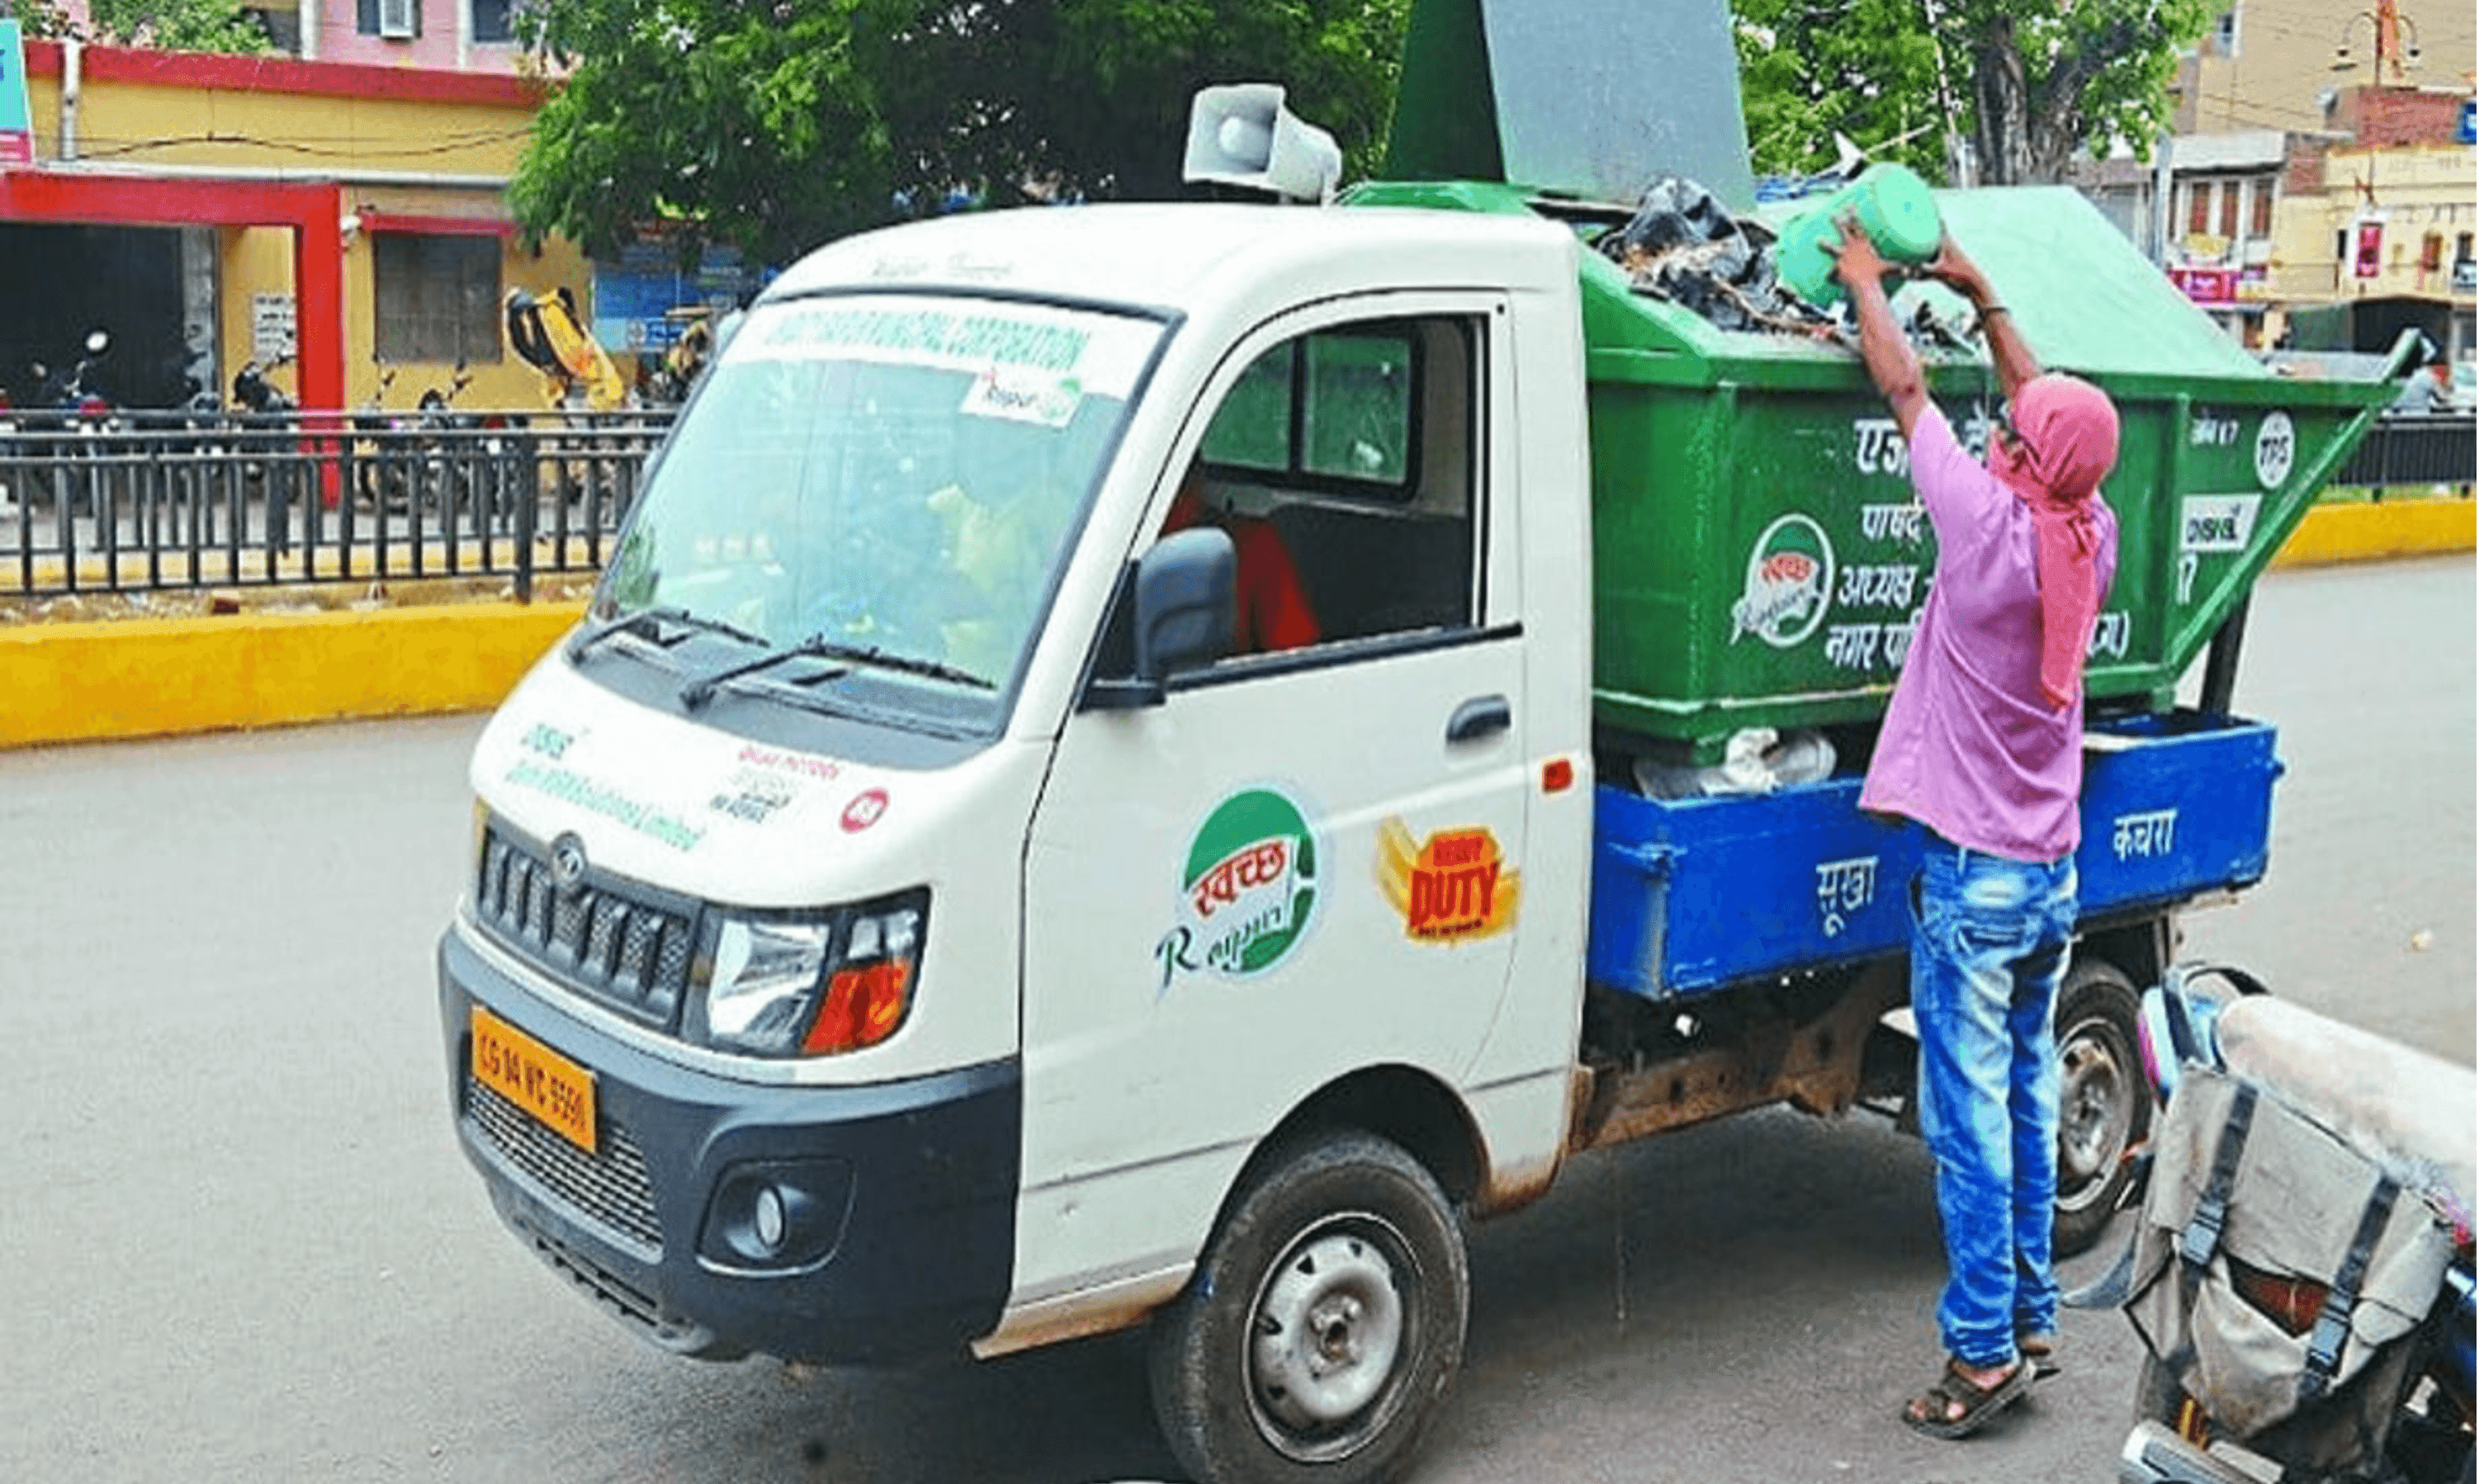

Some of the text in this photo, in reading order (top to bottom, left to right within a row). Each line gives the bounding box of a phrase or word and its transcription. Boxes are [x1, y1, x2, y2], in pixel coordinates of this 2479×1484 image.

[1825, 623, 1881, 671] नगर
[2113, 807, 2177, 863] कचरा
[1195, 841, 1285, 919] स्वच्छ
[1409, 859, 1500, 927] DUTY
[1816, 855, 1880, 937] सूखा
